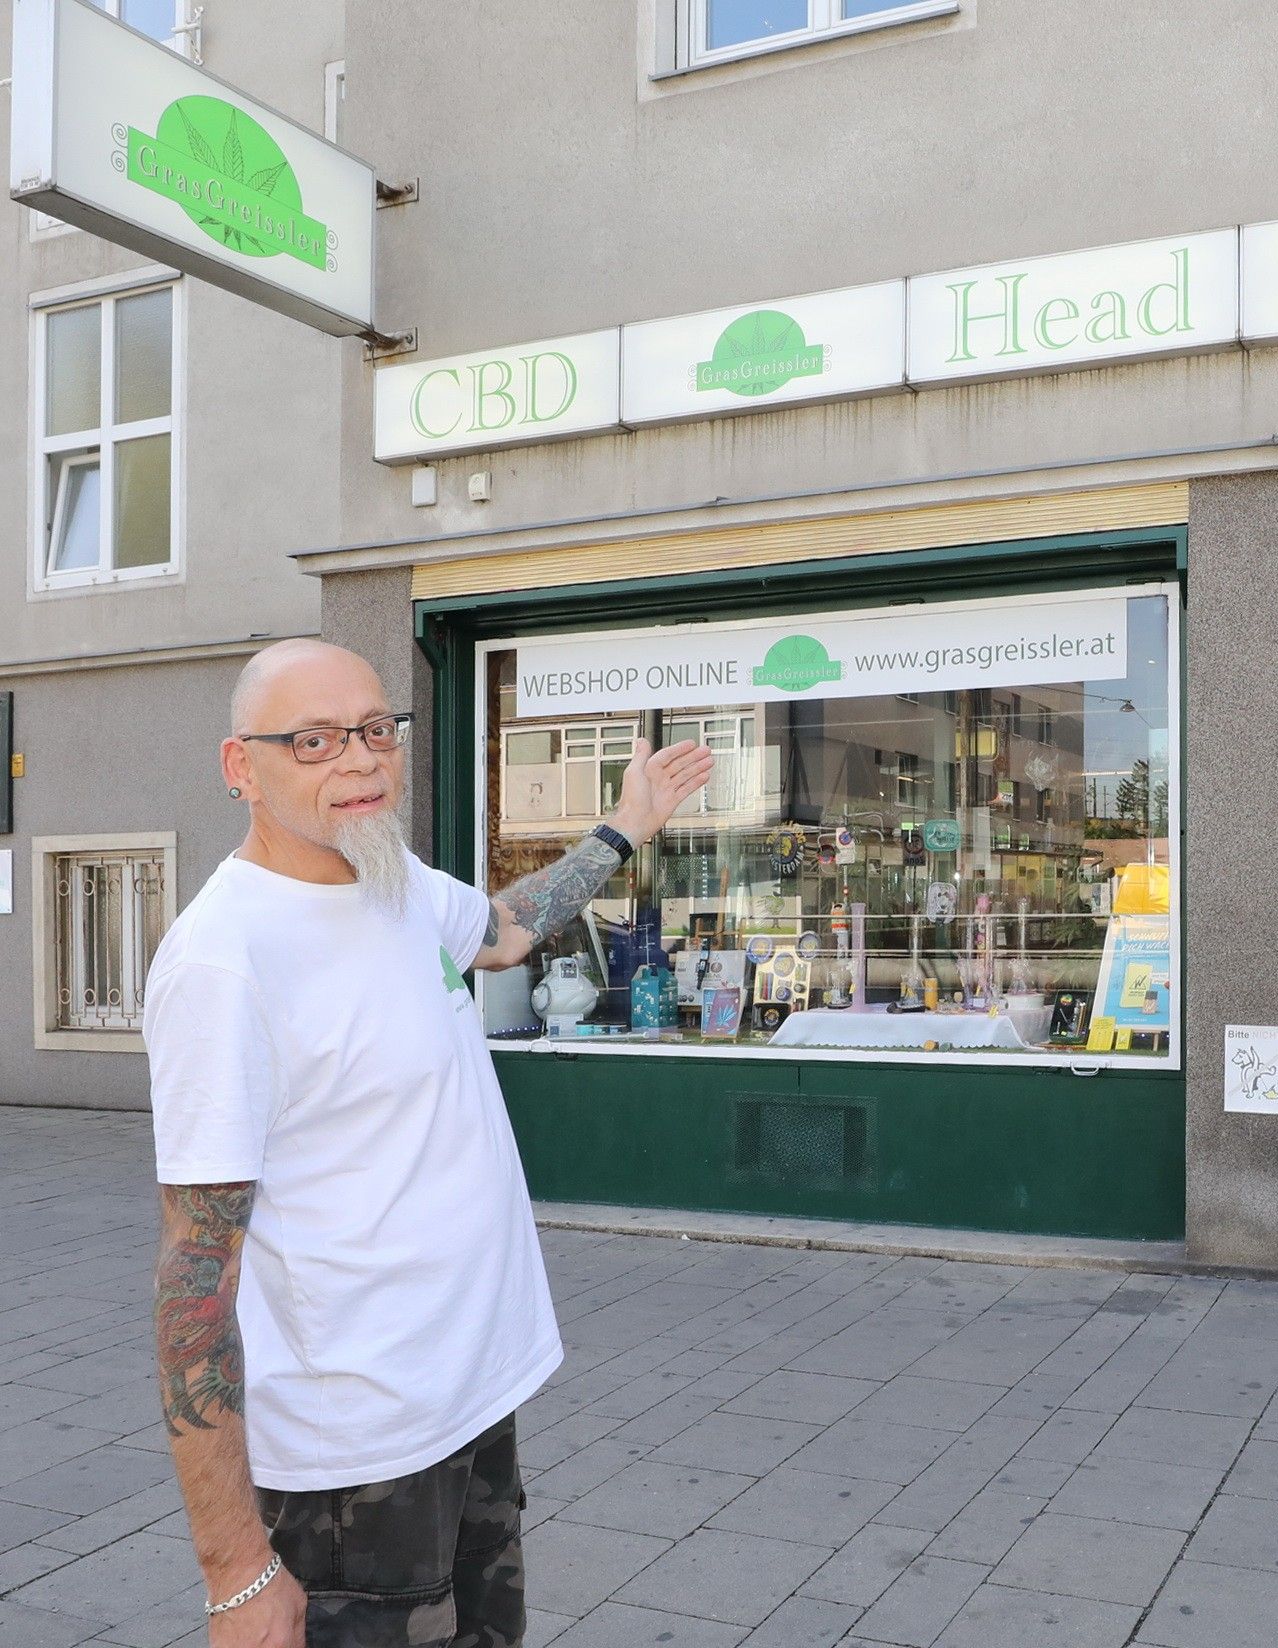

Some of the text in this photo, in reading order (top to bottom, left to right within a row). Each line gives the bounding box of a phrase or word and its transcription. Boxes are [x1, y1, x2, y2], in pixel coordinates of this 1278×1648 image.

[137, 144, 321, 256] GrasGreissler
[944, 247, 1195, 364] Head
[701, 354, 823, 385] GrasGreissler
[409, 350, 578, 440] CBD
[855, 631, 1116, 676] www.grasgreissler.at
[523, 660, 739, 698] WEBSHOP ONLINE
[1227, 1030, 1250, 1039] Bitte
